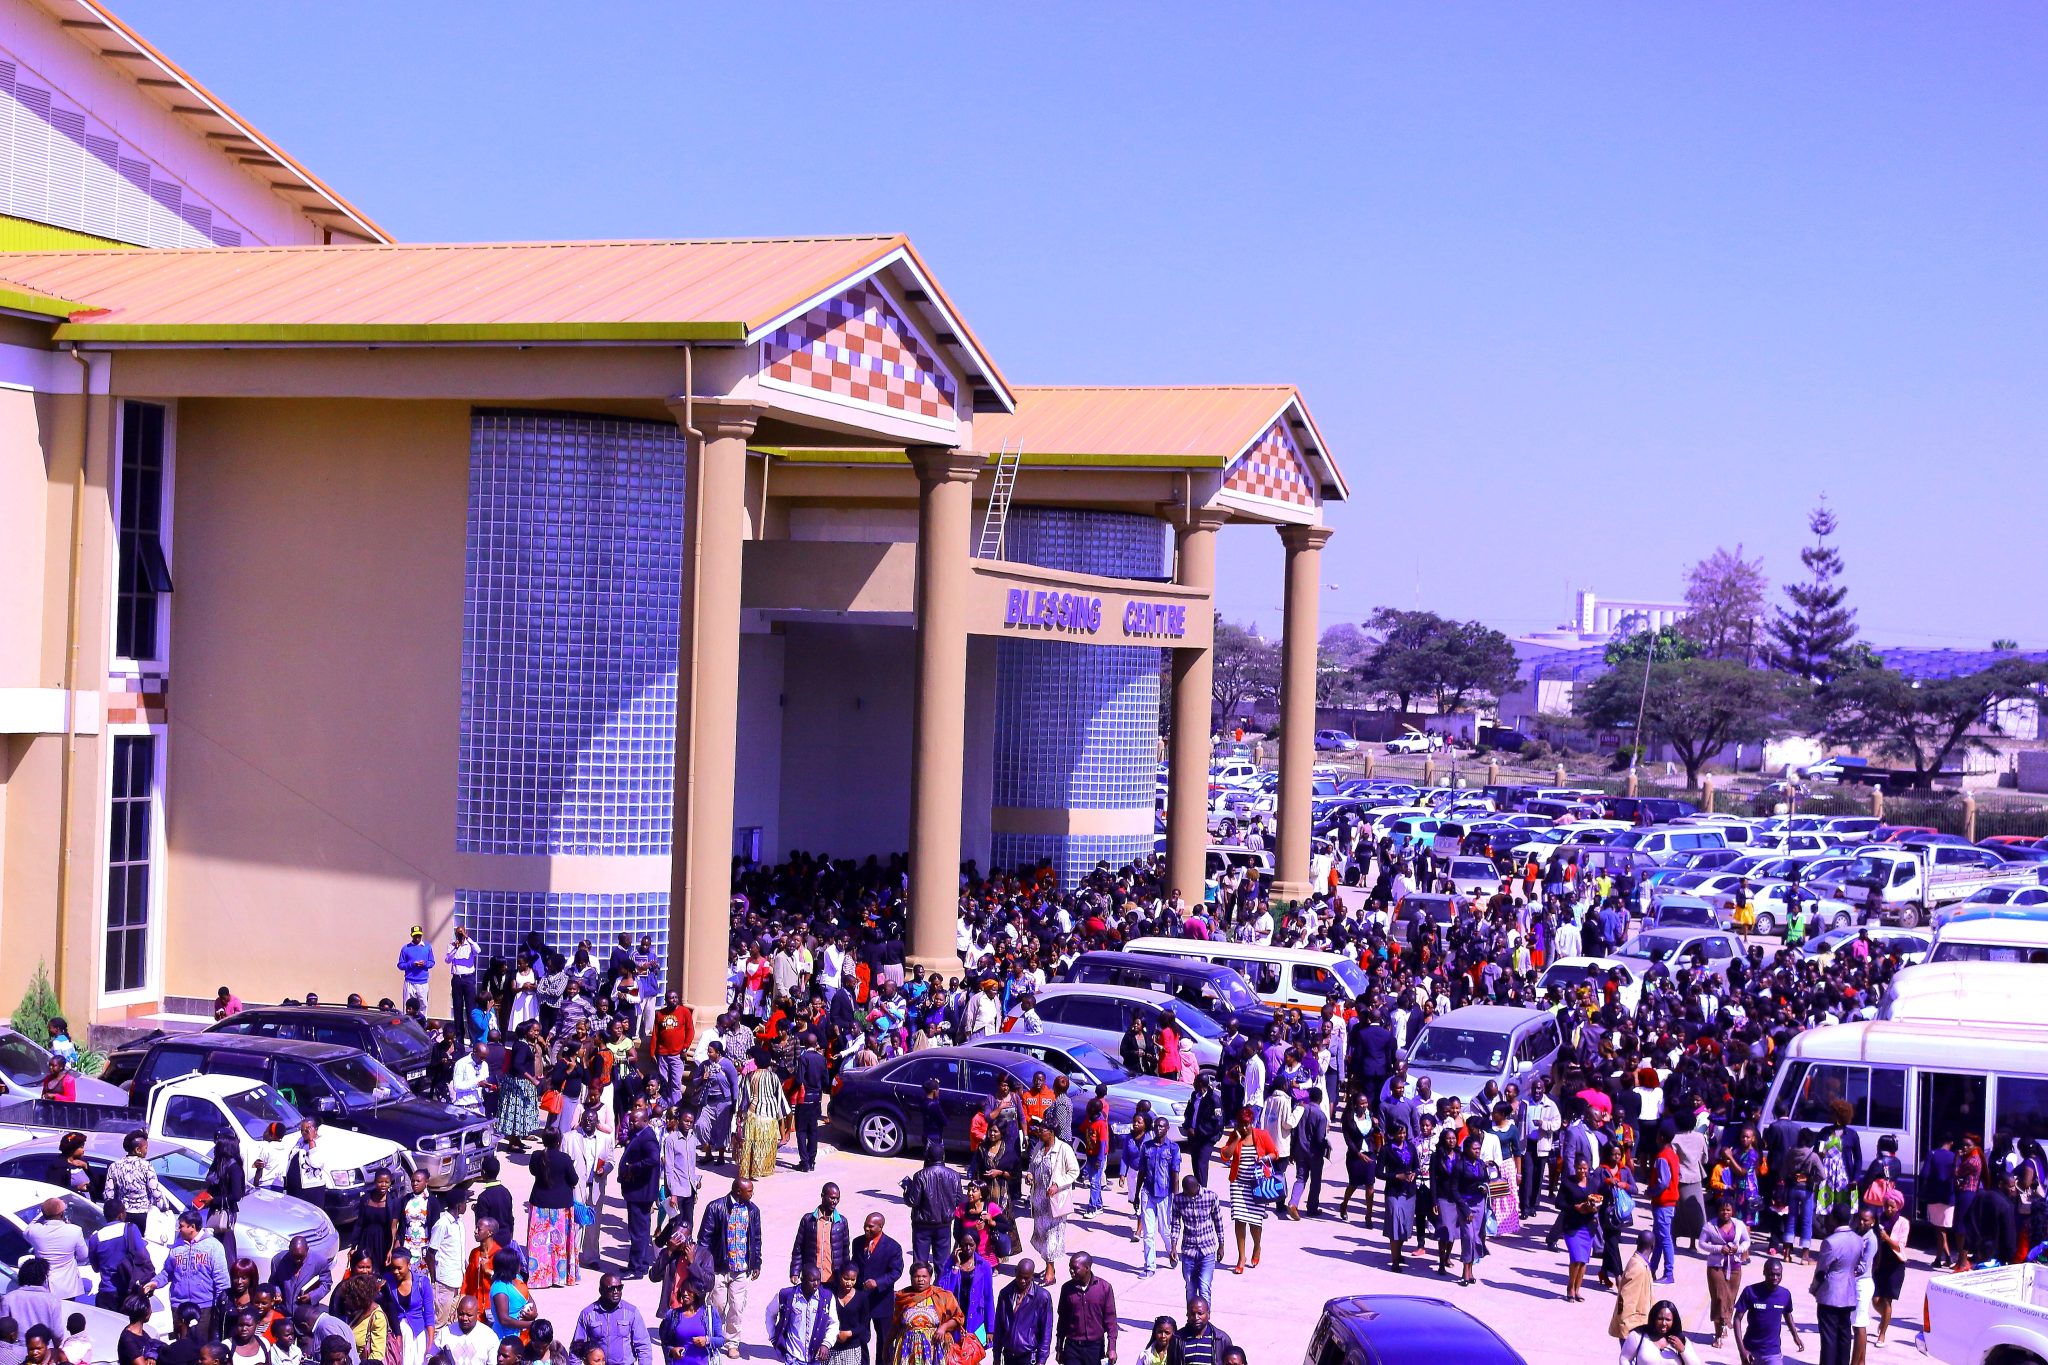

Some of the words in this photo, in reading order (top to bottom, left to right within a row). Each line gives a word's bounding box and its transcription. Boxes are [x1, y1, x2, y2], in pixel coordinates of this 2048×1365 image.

[1006, 588, 1102, 632] BLESSING
[1123, 601, 1186, 635] CENTRE
[1983, 1298, 2009, 1309] LABOUR
